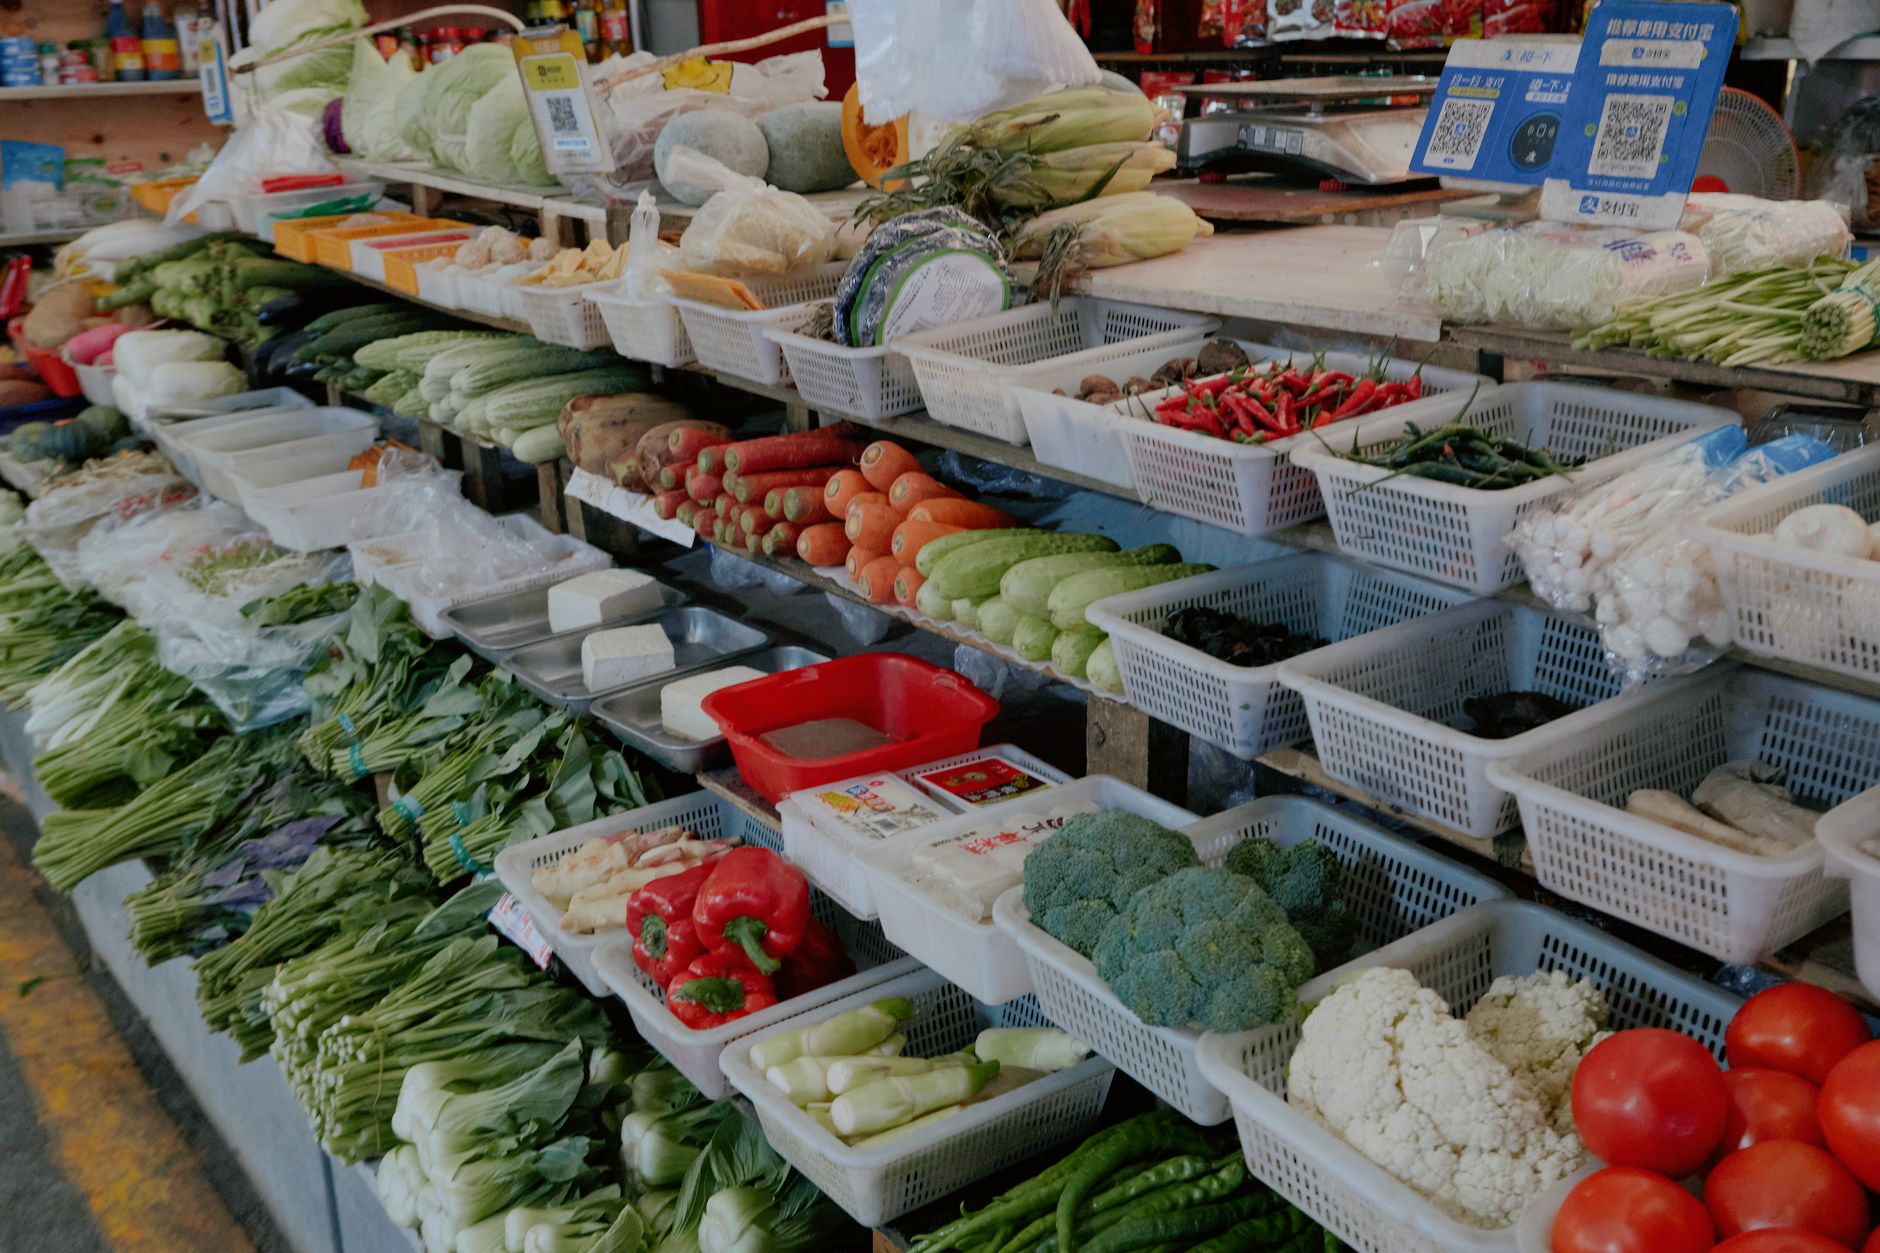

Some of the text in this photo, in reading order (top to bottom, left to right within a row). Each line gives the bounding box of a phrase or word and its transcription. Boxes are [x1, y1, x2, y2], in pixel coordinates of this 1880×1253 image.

[1606, 19, 1713, 41] 推荐使用支付宝
[1646, 48, 1671, 60] 支付宝
[1605, 73, 1684, 89] 推荐使用支付宝
[1601, 199, 1640, 218] 支付宝
